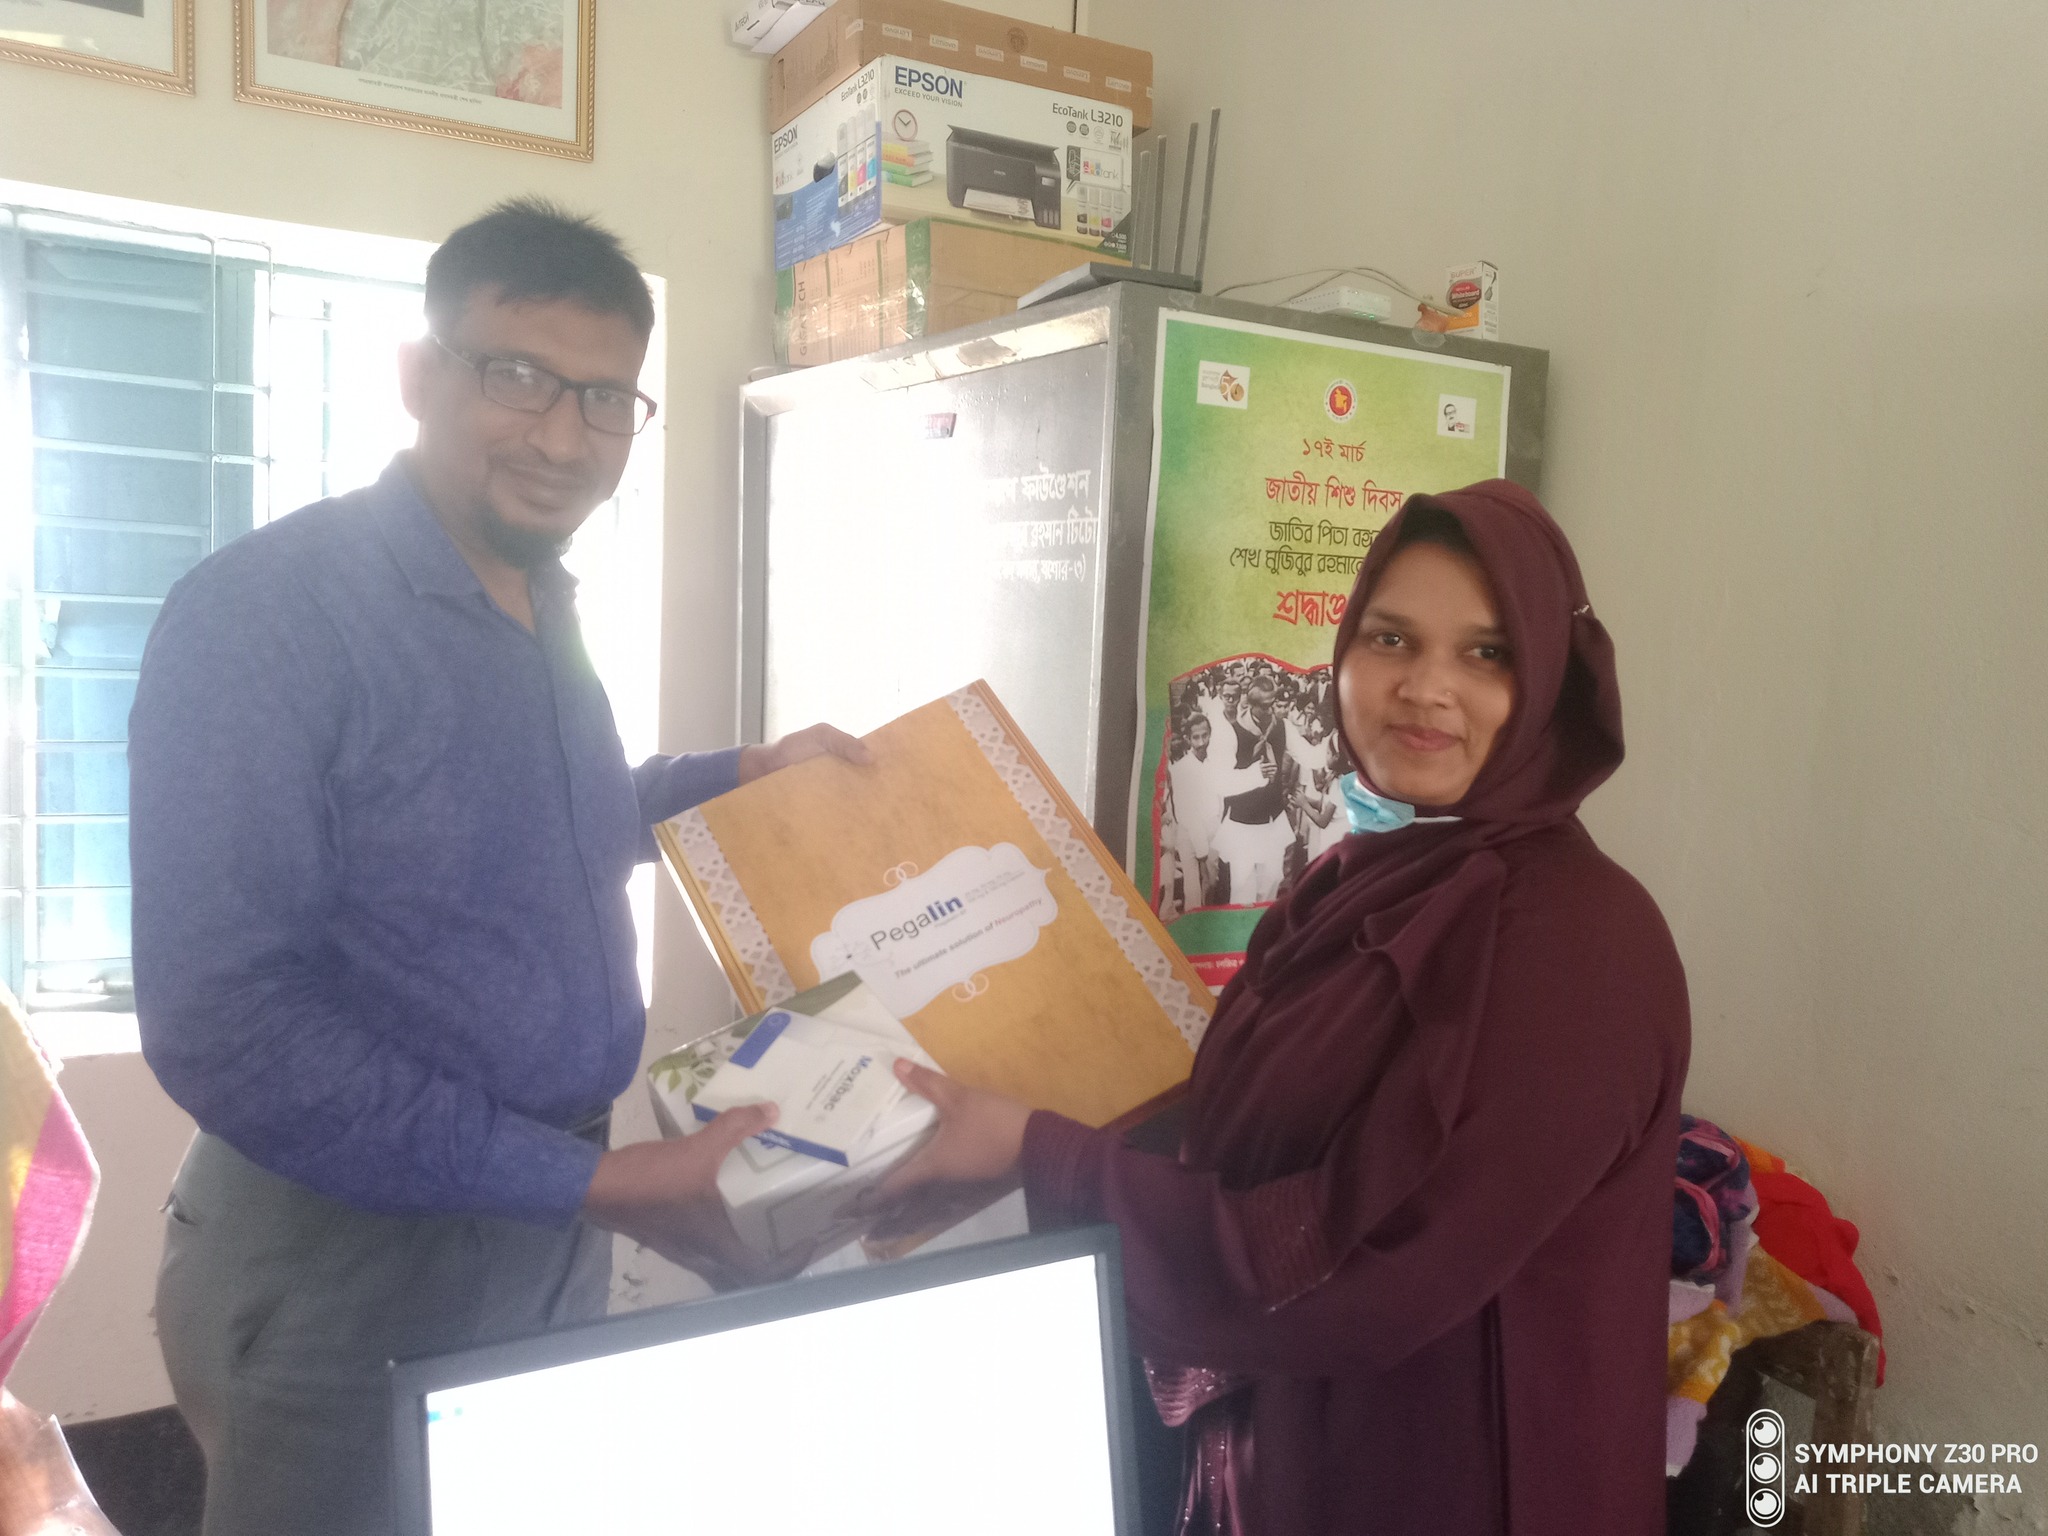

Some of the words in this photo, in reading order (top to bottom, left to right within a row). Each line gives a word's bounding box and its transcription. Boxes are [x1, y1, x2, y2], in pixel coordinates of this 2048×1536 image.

[841, 84, 858, 102] EcoTank
[858, 69, 875, 89] L3210
[894, 87, 920, 98] EXCEED
[922, 93, 940, 103] YOUR
[941, 98, 963, 108] VISION
[895, 65, 963, 99] EPSON
[1052, 102, 1089, 121] EcoTank
[1090, 109, 1124, 128] L3210
[773, 124, 799, 154] EPSON
[1303, 438, 1334, 459] ১৭ই
[1338, 440, 1367, 463] মার্চ
[1265, 470, 1320, 506] জাতীয়
[1325, 475, 1357, 510] শিশু
[1362, 479, 1404, 513] দিবস
[1268, 516, 1314, 544] জাতির
[1317, 519, 1349, 547] পিতা
[1229, 547, 1261, 569] শেখ
[1265, 544, 1314, 577] মুজিবুর
[869, 896, 964, 951] Pegalin
[894, 966, 912, 980] The
[913, 947, 948, 970] ultimate
[949, 928, 985, 951] solution
[984, 922, 994, 934] of
[994, 897, 1043, 926] Neuropathy
